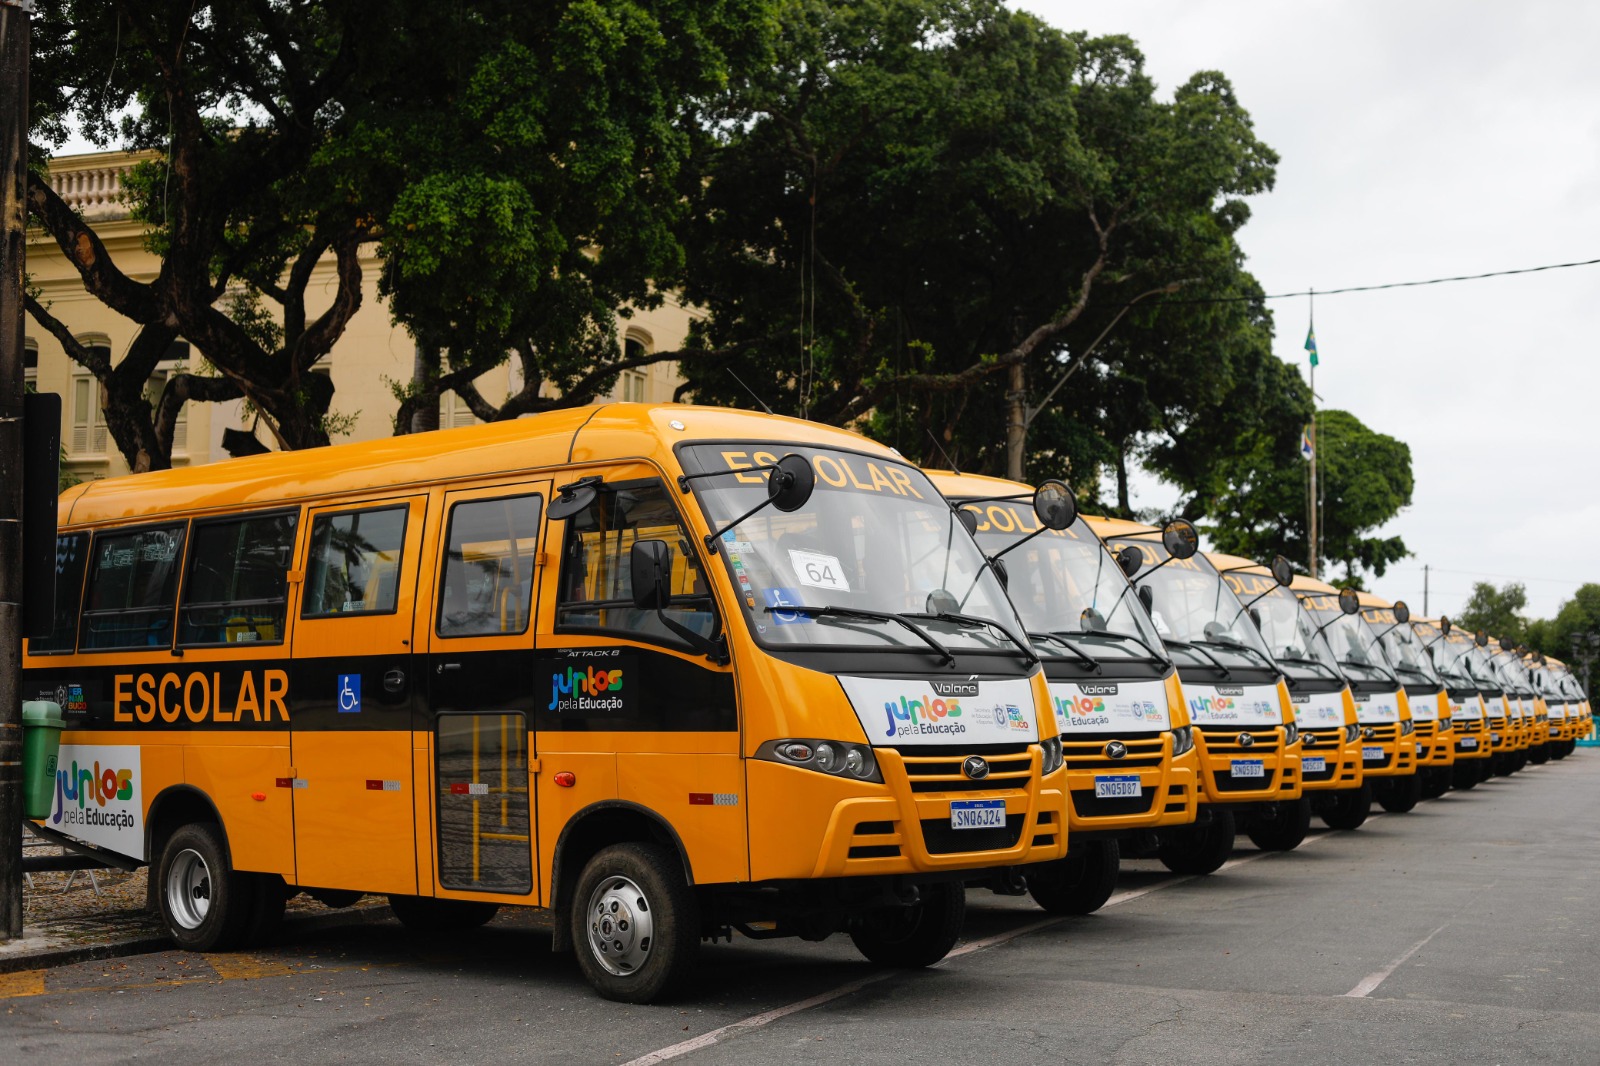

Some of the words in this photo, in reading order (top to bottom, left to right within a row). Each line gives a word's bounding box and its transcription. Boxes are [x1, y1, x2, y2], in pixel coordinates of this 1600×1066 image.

[721, 451, 925, 500] ESOLAR
[805, 563, 837, 585] 64
[114, 669, 290, 723] ESCOLAR
[548, 665, 623, 711] juntos
[935, 683, 977, 693] Volare
[1081, 685, 1116, 694] Volare
[1217, 687, 1243, 695] Volare
[68, 702, 87, 710] BUCO
[558, 697, 578, 712] pela
[579, 696, 623, 711] Educação
[1190, 695, 1235, 720] juntos
[884, 694, 962, 737] juntos
[1072, 715, 1109, 726] Educação
[1211, 711, 1238, 719] Educação
[897, 724, 920, 738] pela
[920, 722, 966, 735] Educação
[1010, 721, 1029, 729] BUCO
[53, 761, 133, 824] juntos
[1100, 783, 1137, 795] SNQ5D87
[64, 808, 85, 828] pela
[86, 808, 134, 831] Educação
[957, 810, 1001, 826] SNQ6J24
